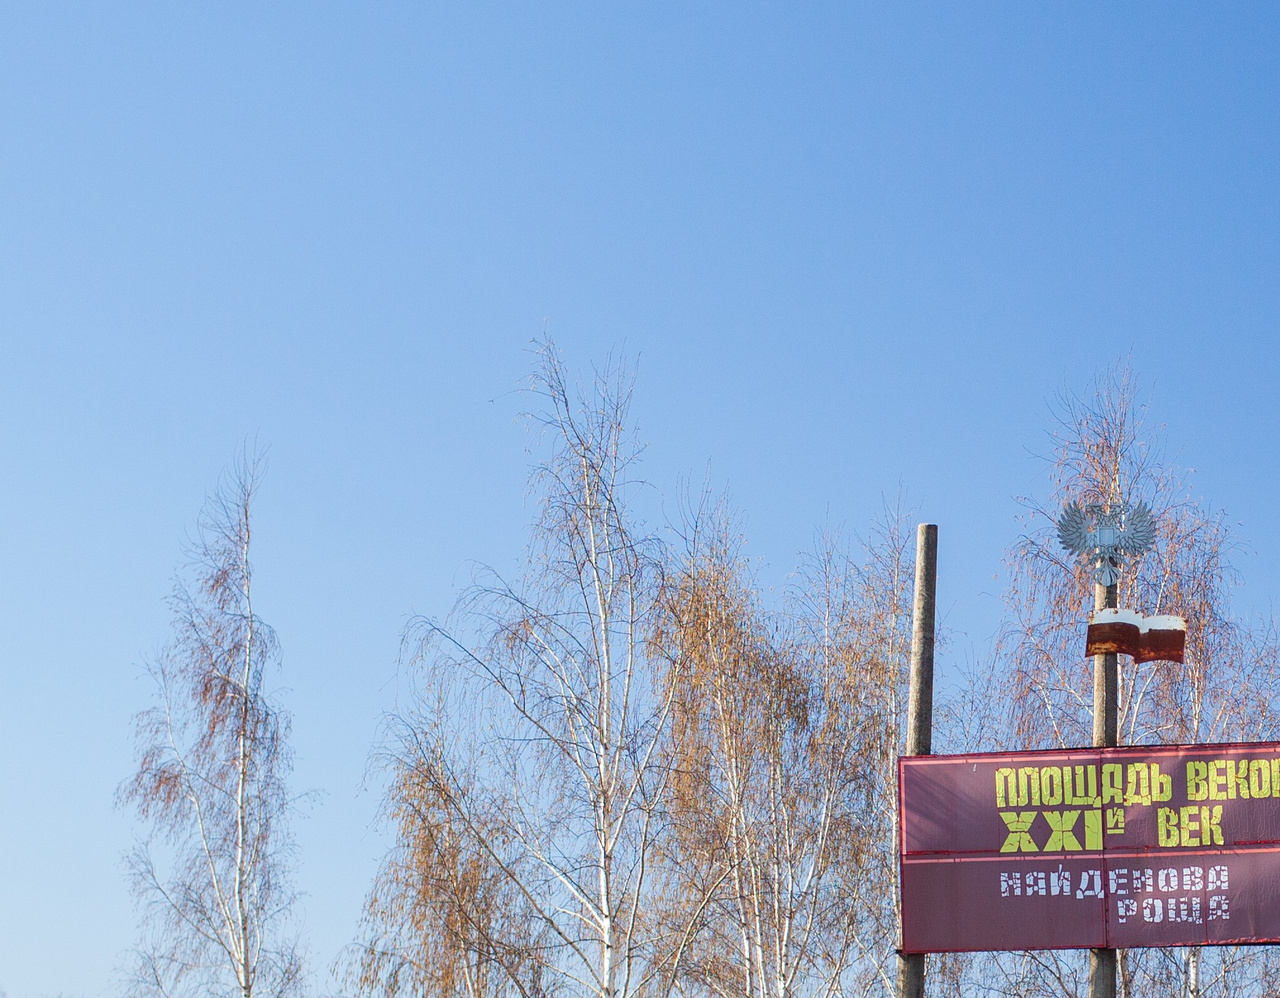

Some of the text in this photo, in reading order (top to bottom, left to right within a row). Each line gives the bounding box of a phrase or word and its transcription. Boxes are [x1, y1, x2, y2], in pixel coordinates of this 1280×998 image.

[996, 761, 1173, 807] ПЛОЩАДЬ
[1158, 805, 1225, 847] ВЕК
[1000, 864, 1229, 899] НАЙДЕНОВА
[1117, 896, 1230, 924] РОЩА
